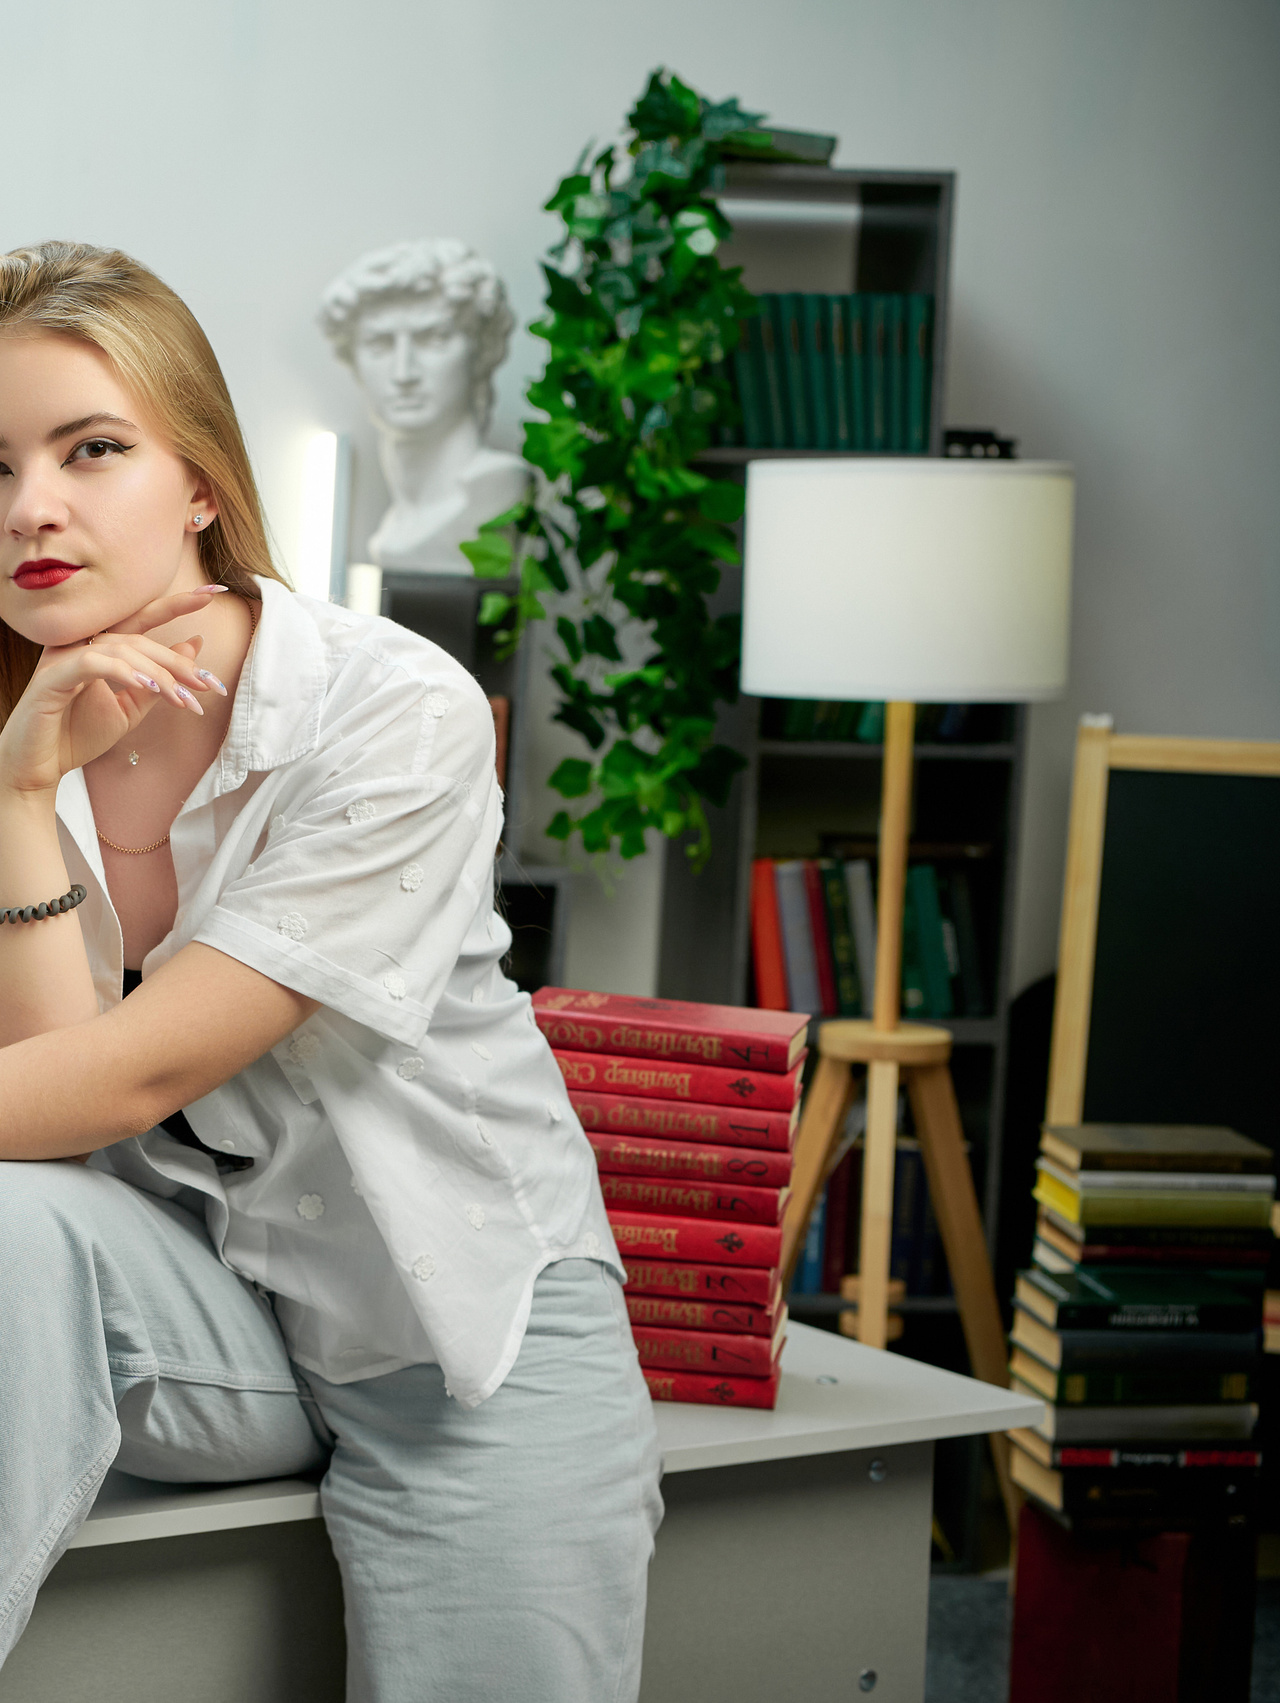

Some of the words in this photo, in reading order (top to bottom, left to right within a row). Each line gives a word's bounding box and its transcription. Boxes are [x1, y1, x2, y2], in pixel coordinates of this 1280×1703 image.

[728, 1044, 770, 1063] 4
[728, 1120, 770, 1140] 1
[726, 1158, 769, 1177] 8
[717, 1196, 756, 1215] 5
[706, 1274, 747, 1293] 3
[712, 1309, 754, 1328] 2
[711, 1345, 752, 1364] 7
